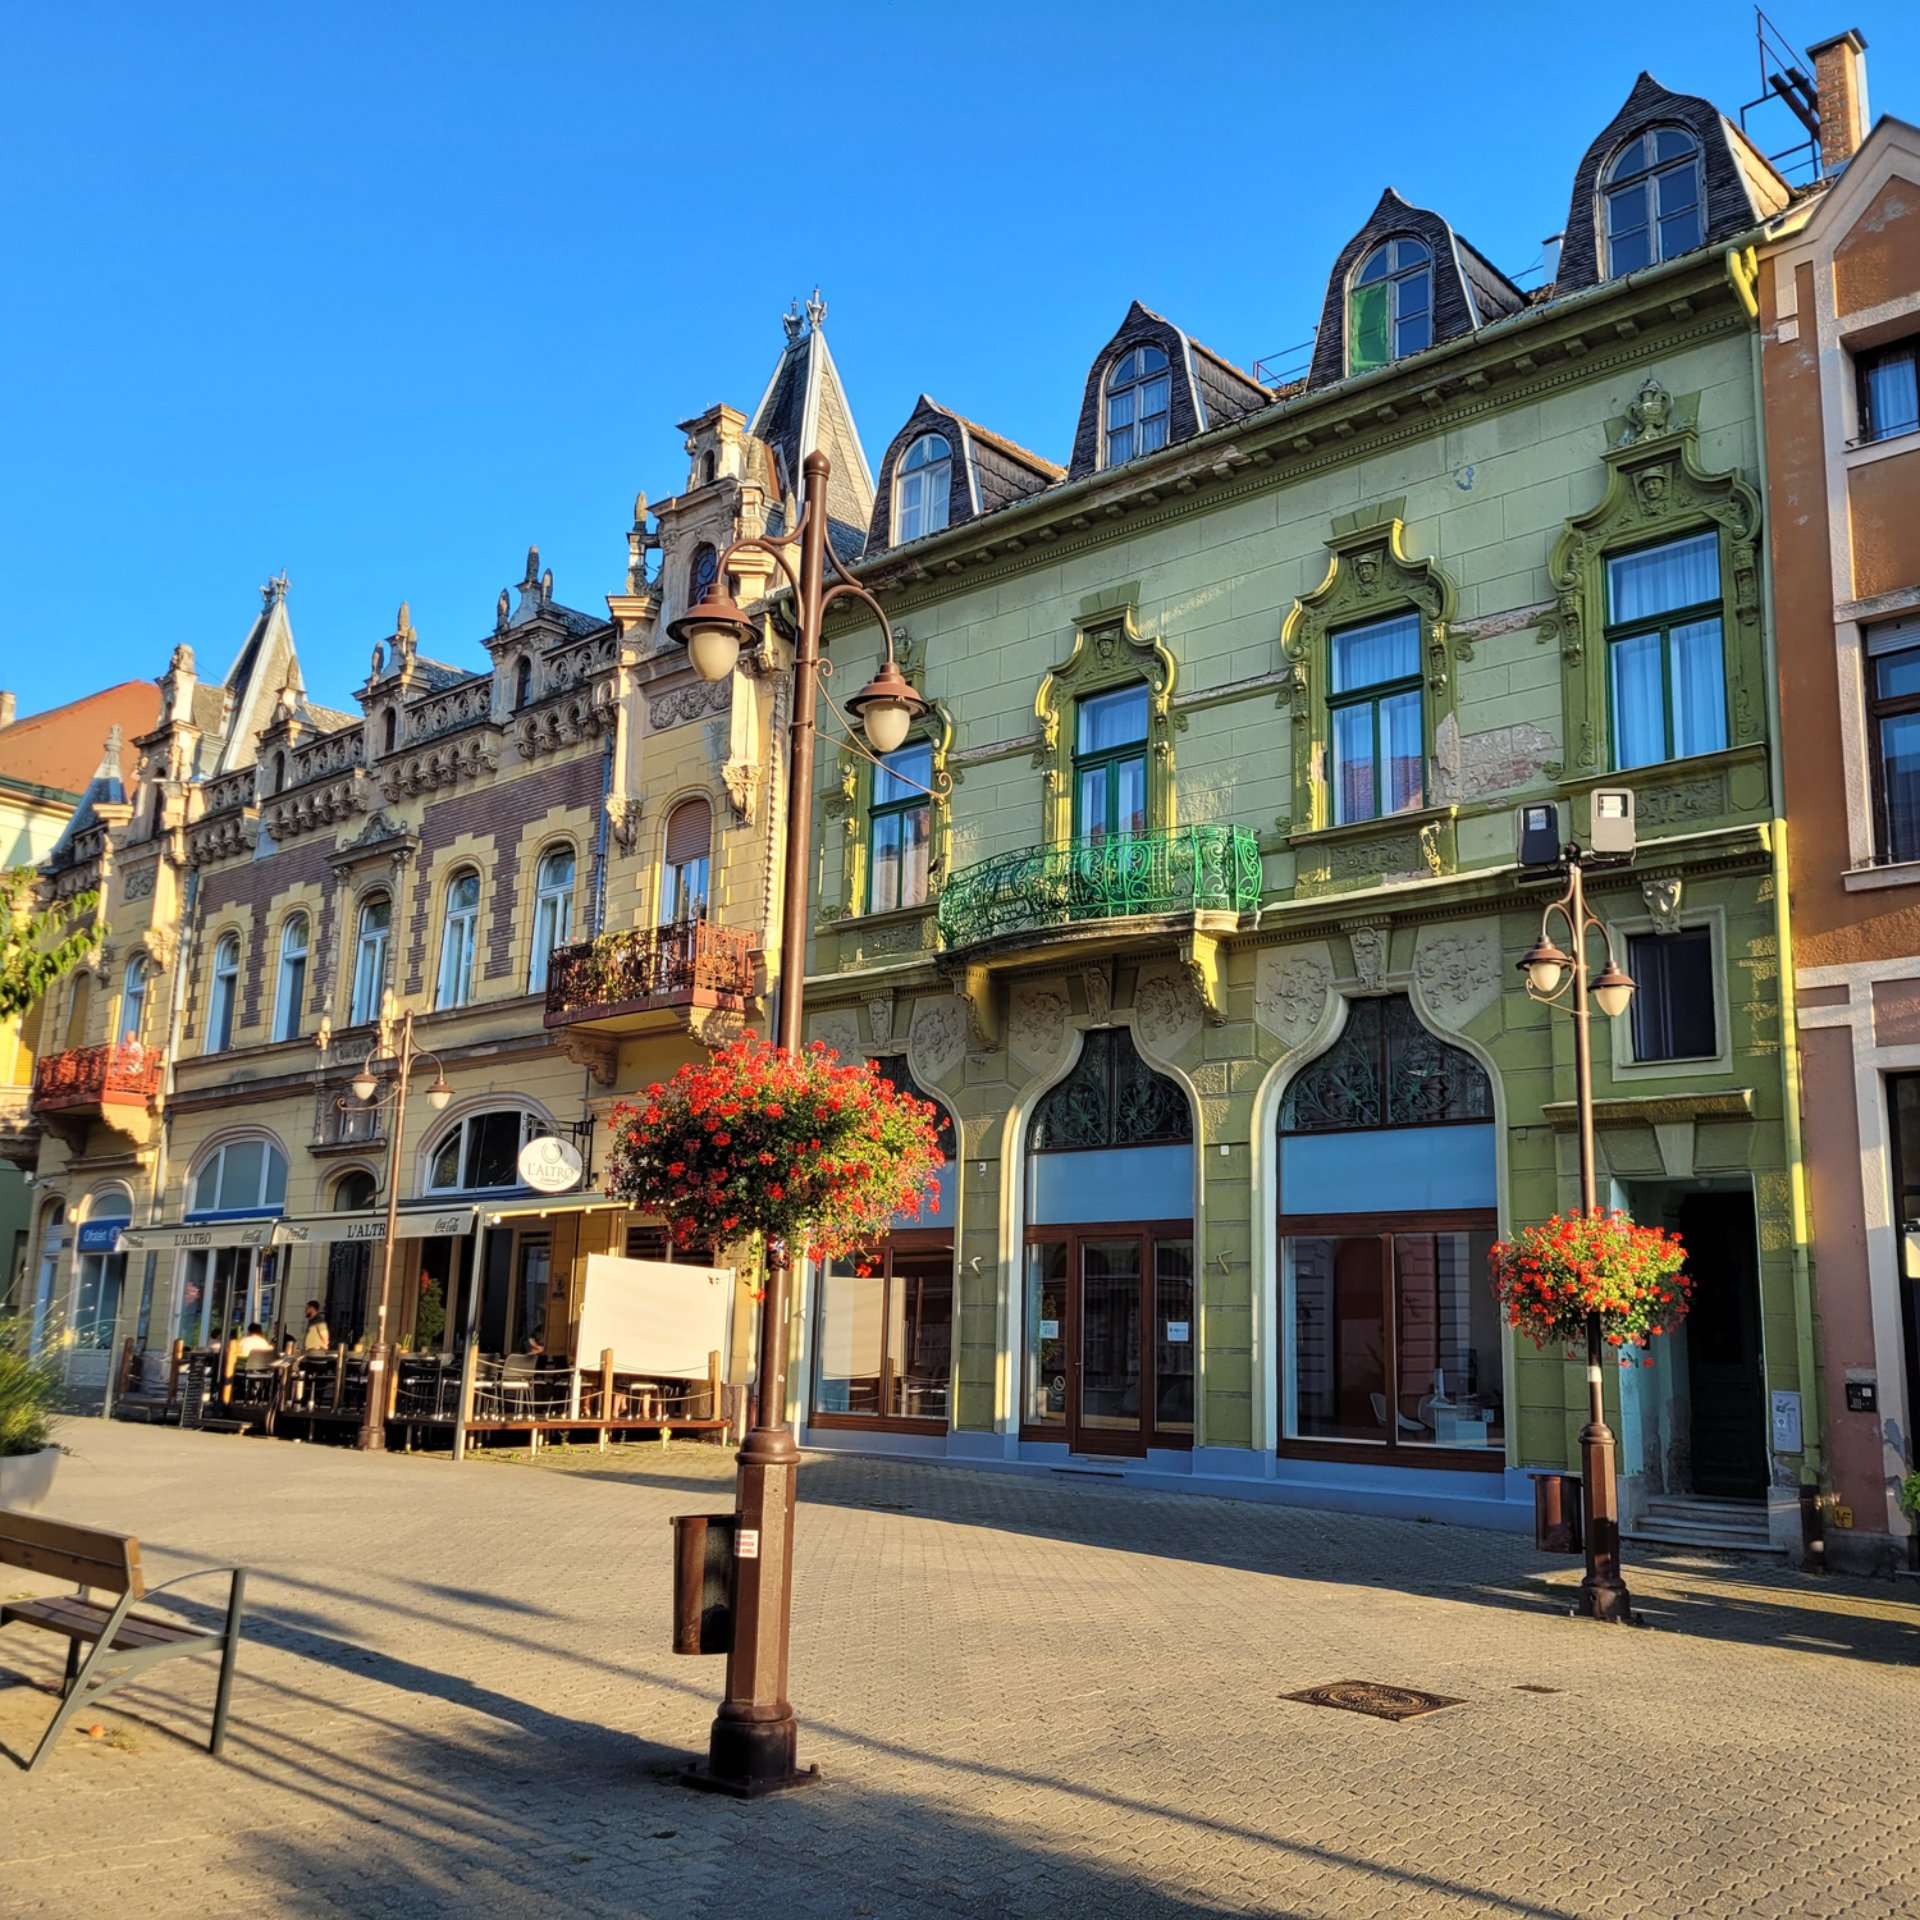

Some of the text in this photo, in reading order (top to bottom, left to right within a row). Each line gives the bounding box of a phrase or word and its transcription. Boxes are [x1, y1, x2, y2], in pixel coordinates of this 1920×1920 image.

[528, 1162, 574, 1178] L'ALTRO
[347, 1223, 386, 1238] L'ALTR
[174, 1232, 212, 1246] L'ALTRO
